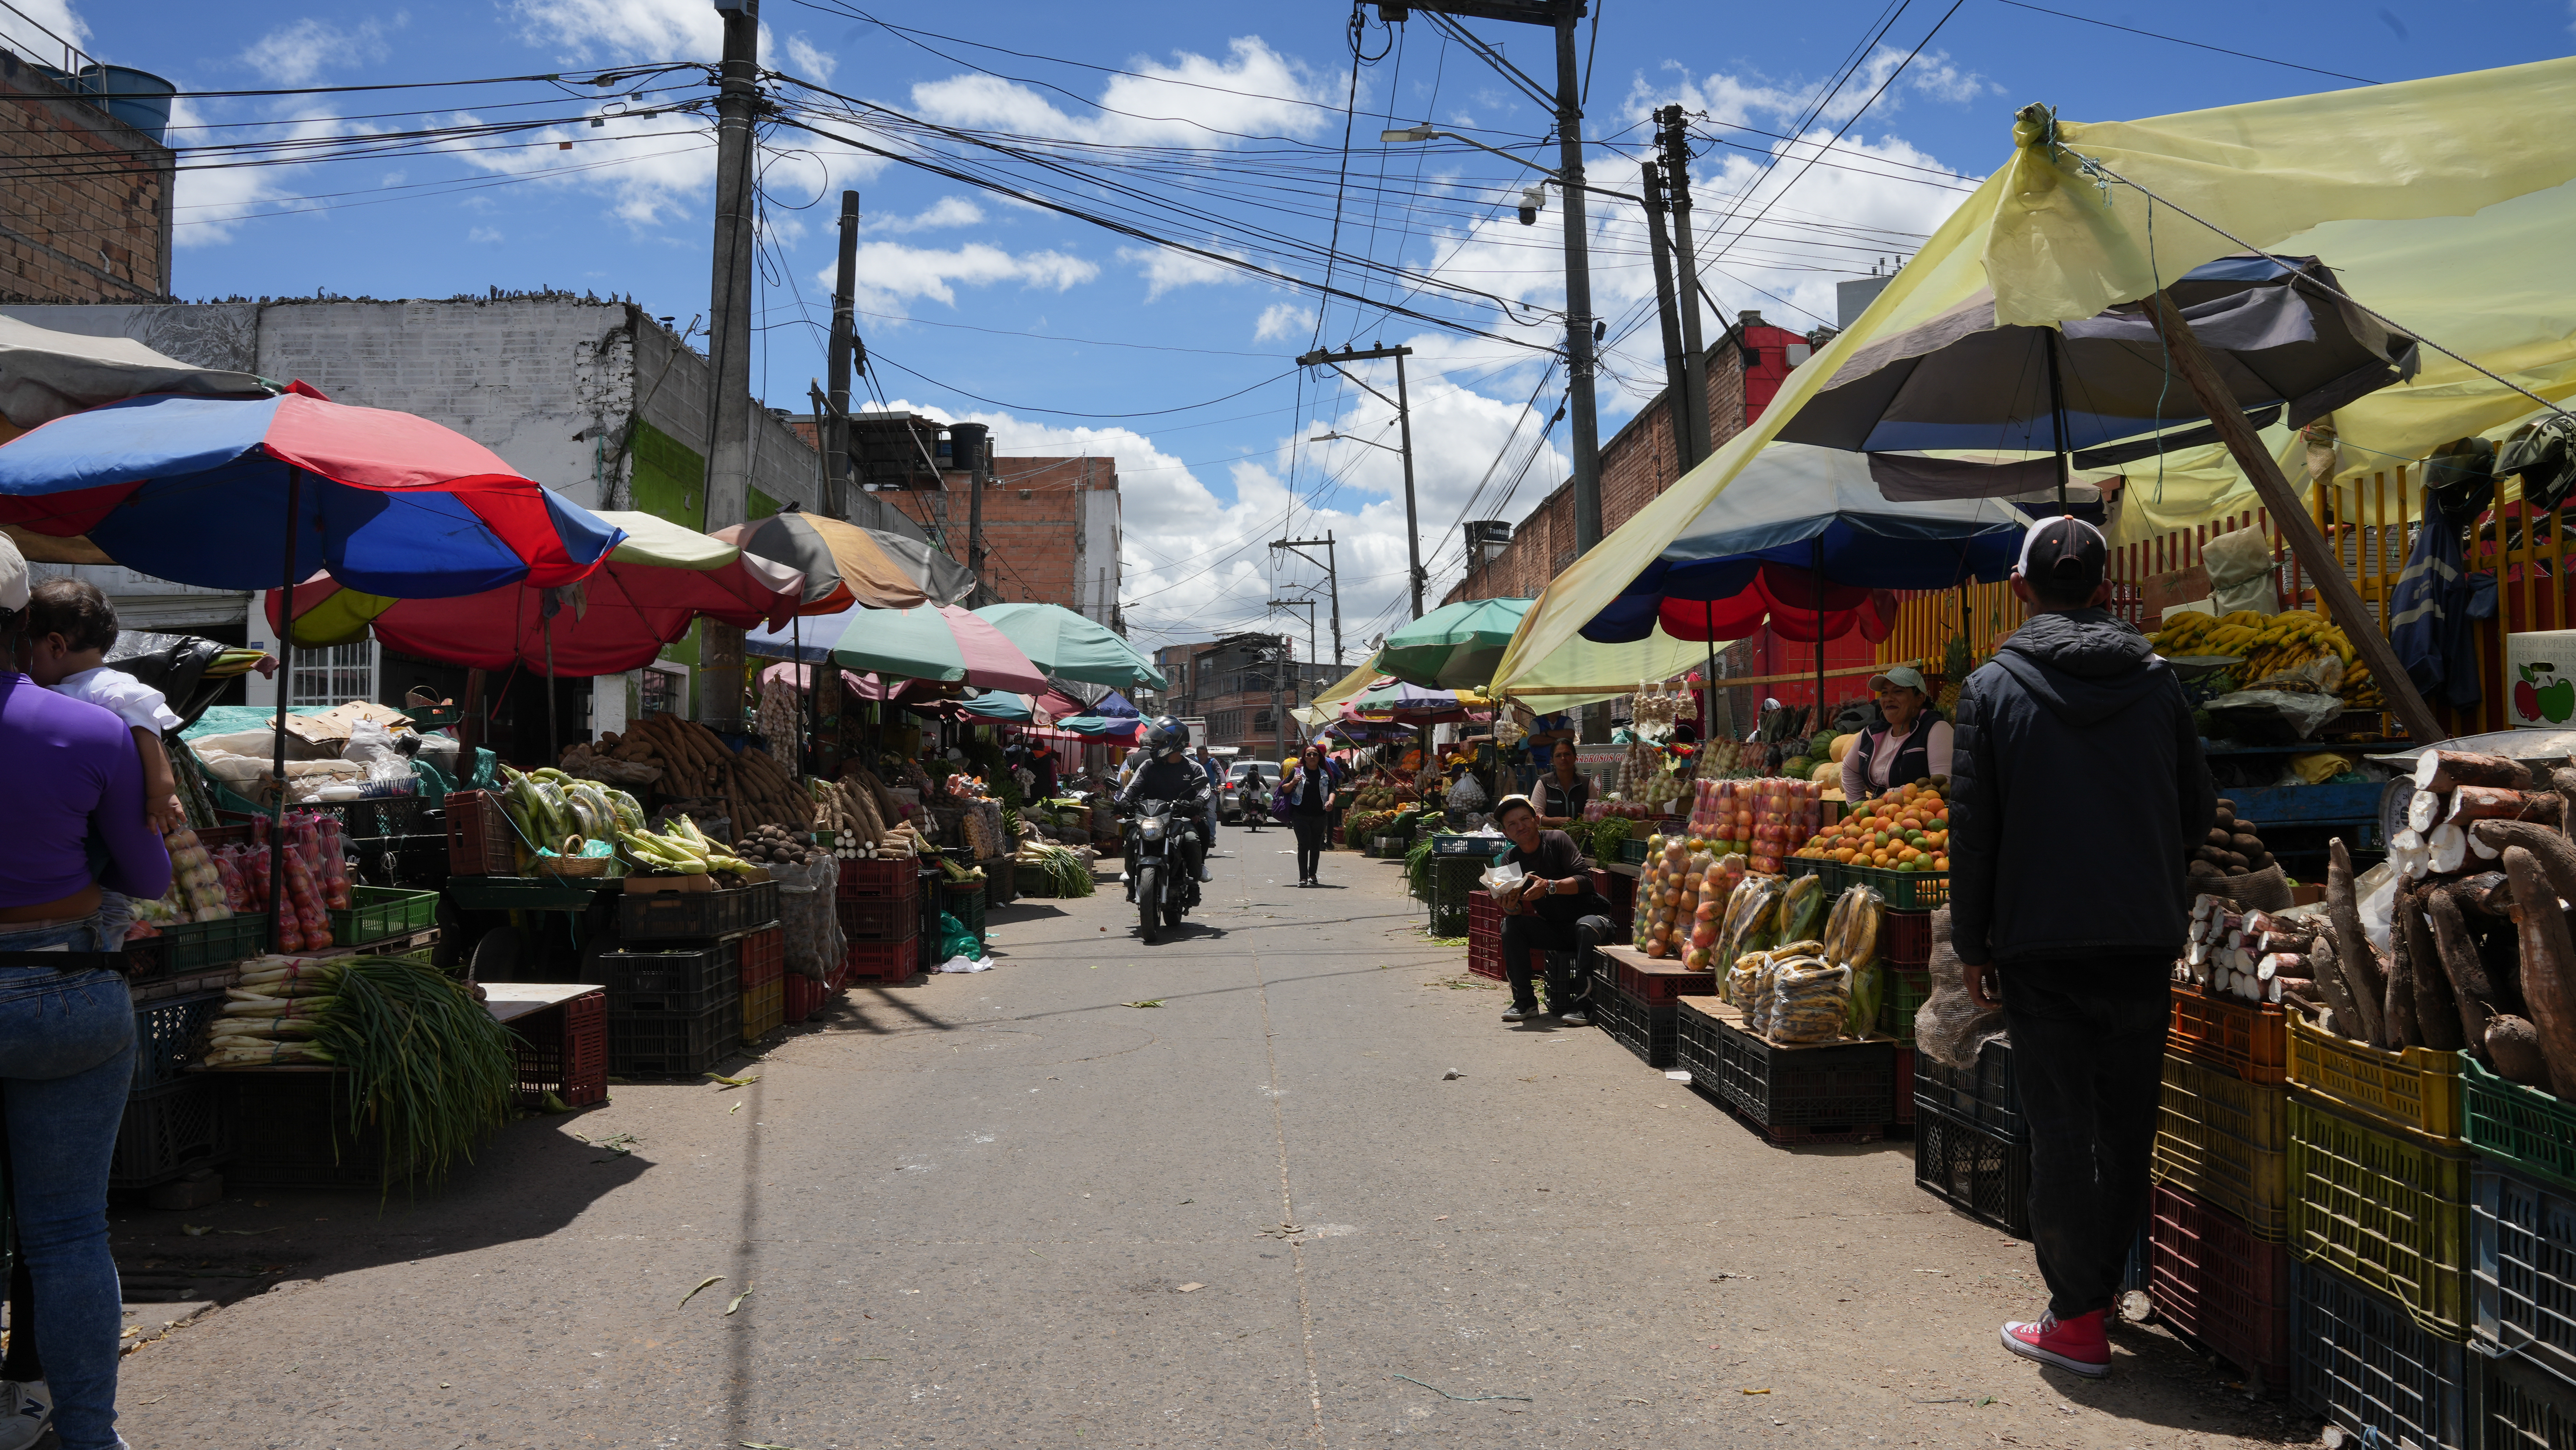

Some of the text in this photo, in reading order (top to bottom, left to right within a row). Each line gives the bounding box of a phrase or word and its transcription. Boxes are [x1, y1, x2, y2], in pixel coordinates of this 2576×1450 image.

[2511, 638, 2576, 649] FRESH APPLES
[2511, 651, 2576, 661] FRESH APPLES
[2554, 665, 2576, 674] PLES
[1574, 753, 1628, 763] SABROSOS GO
